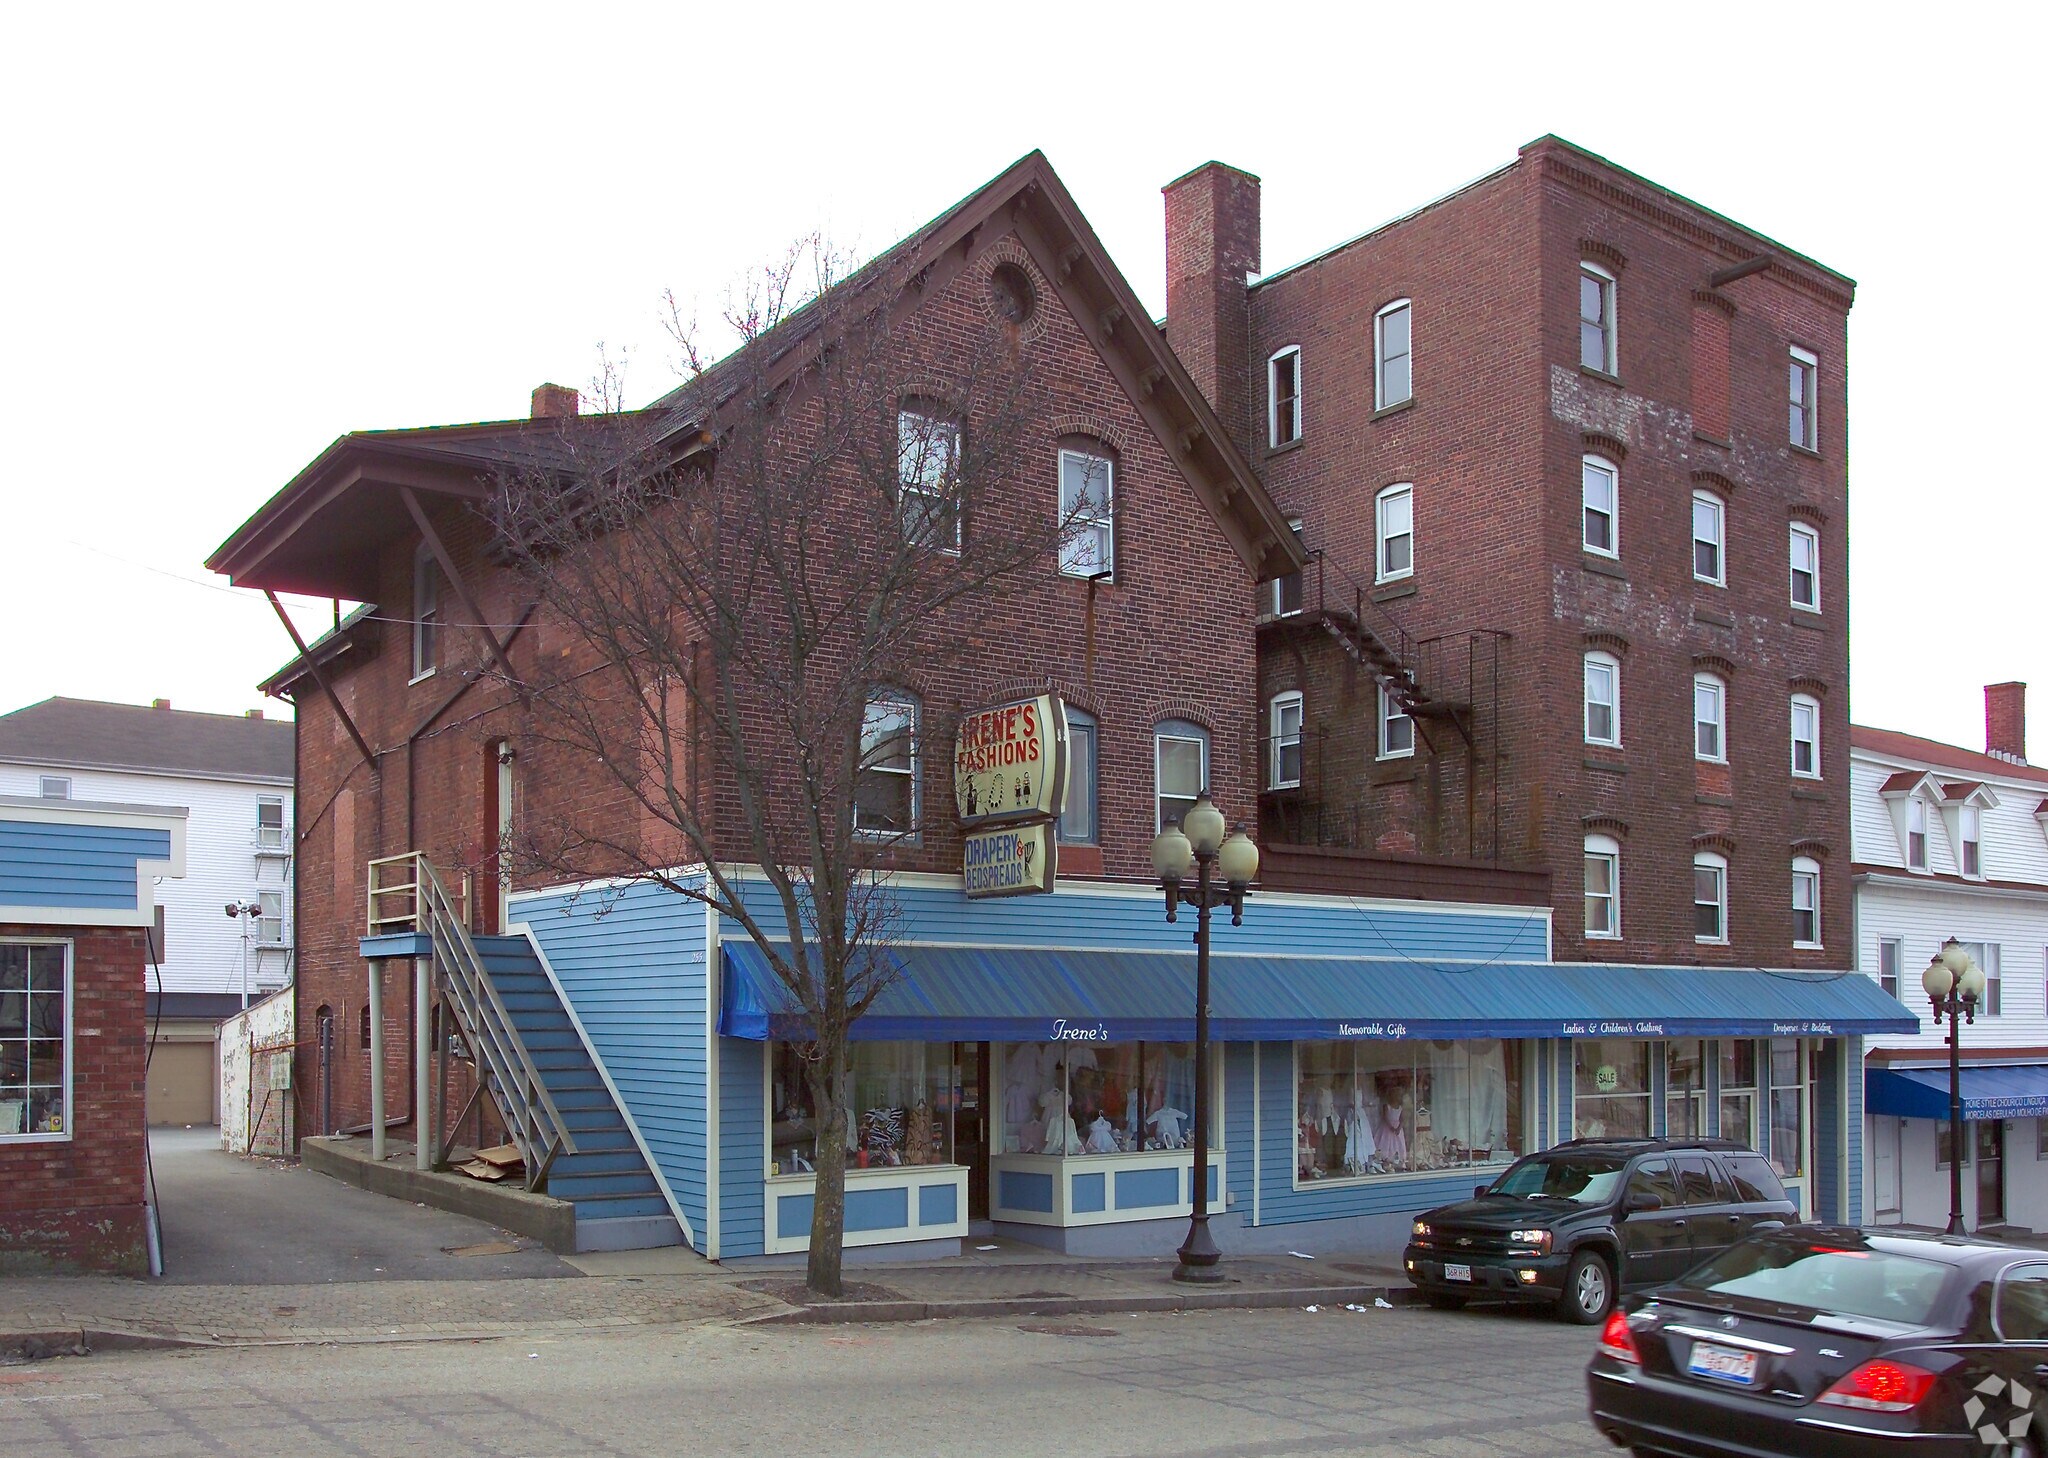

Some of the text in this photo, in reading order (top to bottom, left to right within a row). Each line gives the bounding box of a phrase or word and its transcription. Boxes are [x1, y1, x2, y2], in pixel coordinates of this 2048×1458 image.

[962, 705, 1035, 749] IRENE'S
[958, 737, 1039, 774] FASHIONS
[966, 833, 1024, 866] DRAPERY &
[966, 862, 1022, 890] BEDSPREADS
[1050, 1018, 1108, 1041] Irene's
[1339, 1022, 1407, 1039] Memorable Gifts
[1563, 1022, 1664, 1036] Ladies & Children's Clothing
[1811, 1022, 1833, 1035] Bedding
[1598, 1073, 1615, 1084] SALE
[1965, 1099, 1980, 1109] HOME
[1981, 1098, 1997, 1108] STYLE
[1965, 1109, 1993, 1120] MORCELAS
[2017, 1108, 2034, 1118] MOLHO
[2034, 1107, 2042, 1117] DE
